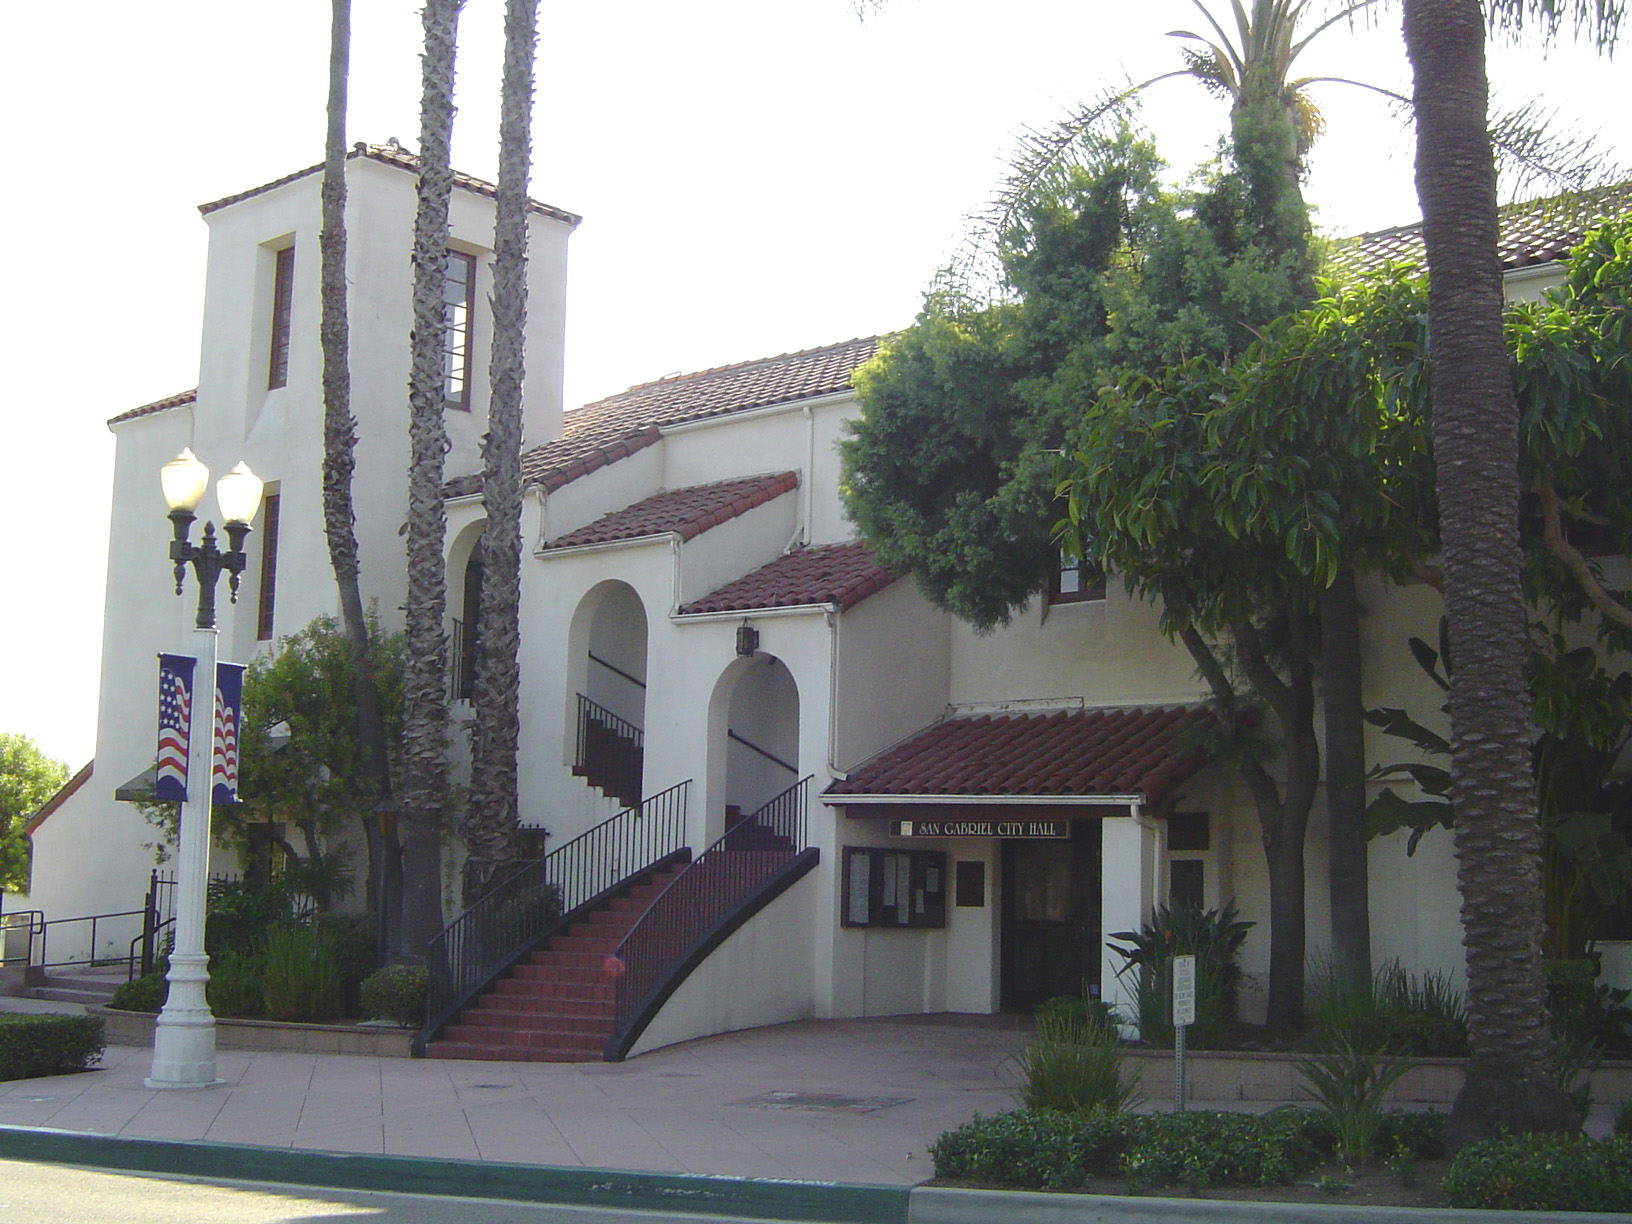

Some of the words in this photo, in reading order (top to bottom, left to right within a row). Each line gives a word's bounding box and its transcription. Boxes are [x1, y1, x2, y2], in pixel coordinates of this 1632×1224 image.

[919, 822, 940, 835] SAN
[944, 822, 993, 836] GABRIEL
[997, 822, 1025, 836] CITY
[1029, 822, 1056, 836] HALL
